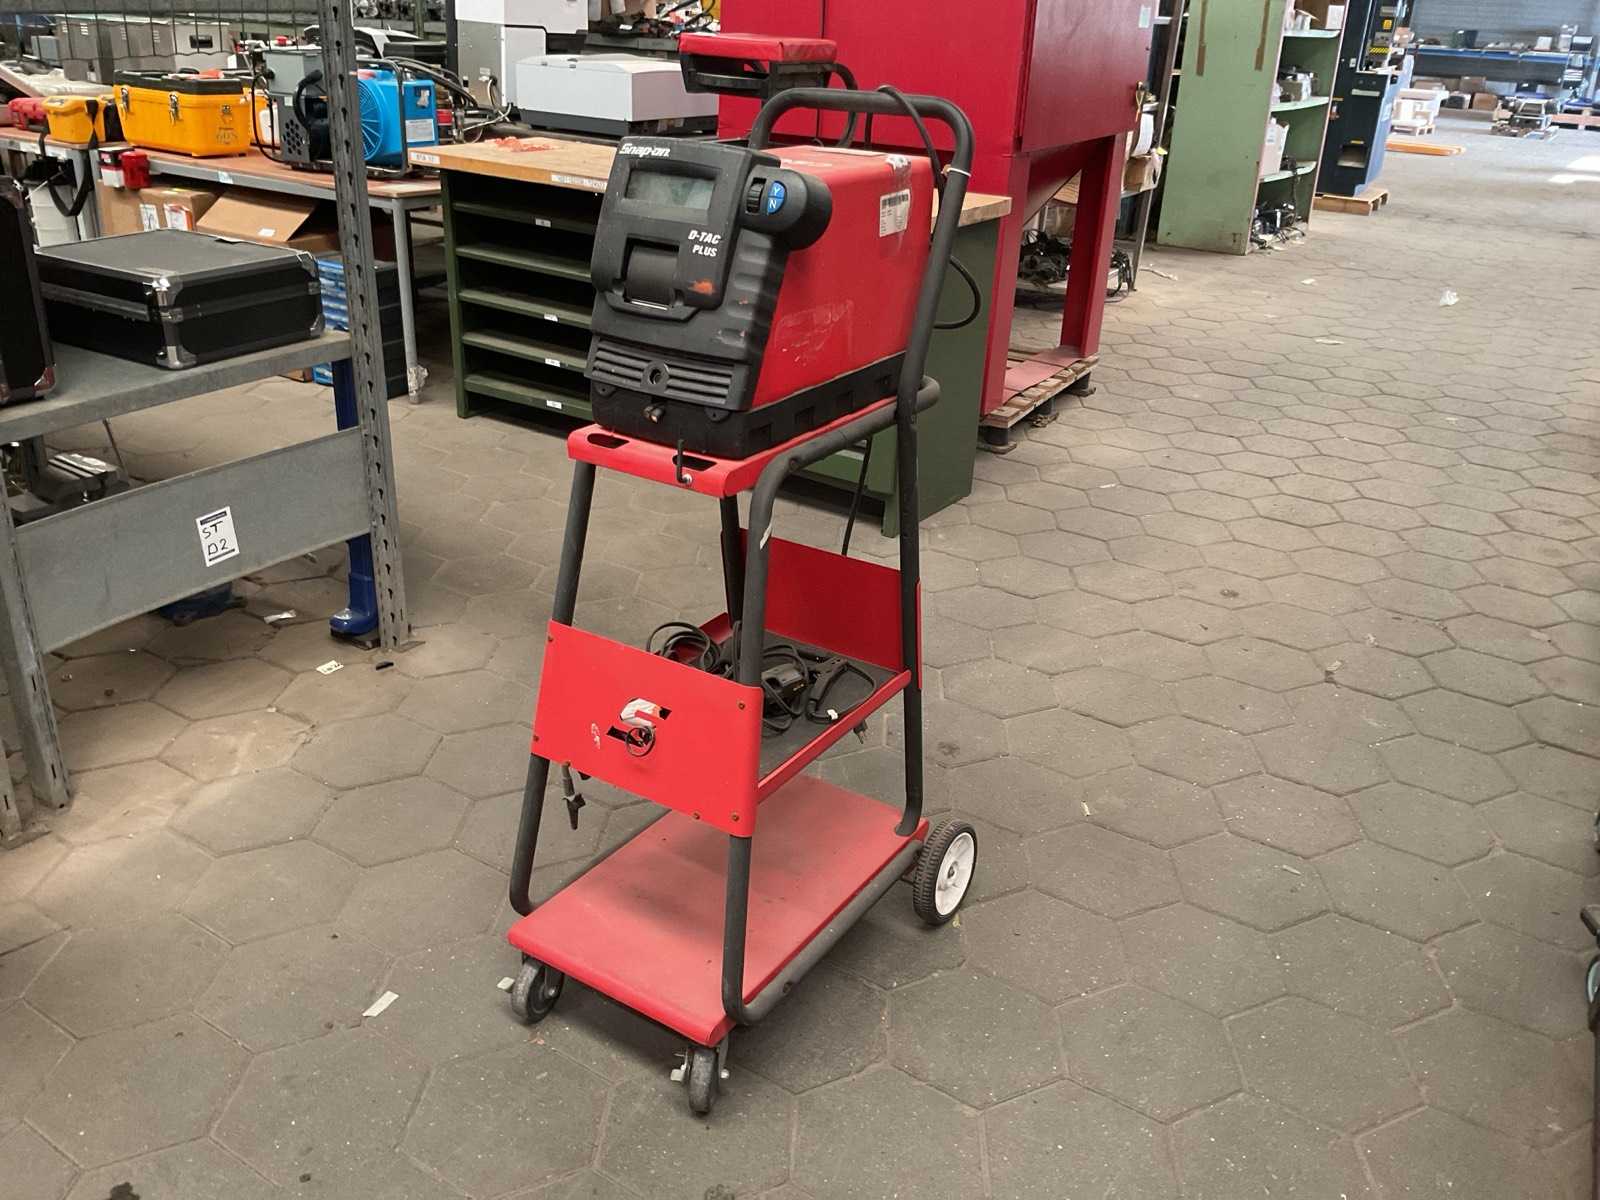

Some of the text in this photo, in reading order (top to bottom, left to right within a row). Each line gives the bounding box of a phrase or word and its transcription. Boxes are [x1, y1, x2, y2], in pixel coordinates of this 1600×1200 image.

[619, 143, 670, 158] Snap-on
[771, 186, 781, 196] Y
[769, 199, 777, 209] N
[688, 230, 722, 245] D-TAC
[692, 245, 718, 257] PLUS
[202, 520, 223, 539] ST
[208, 538, 228, 555] D2
